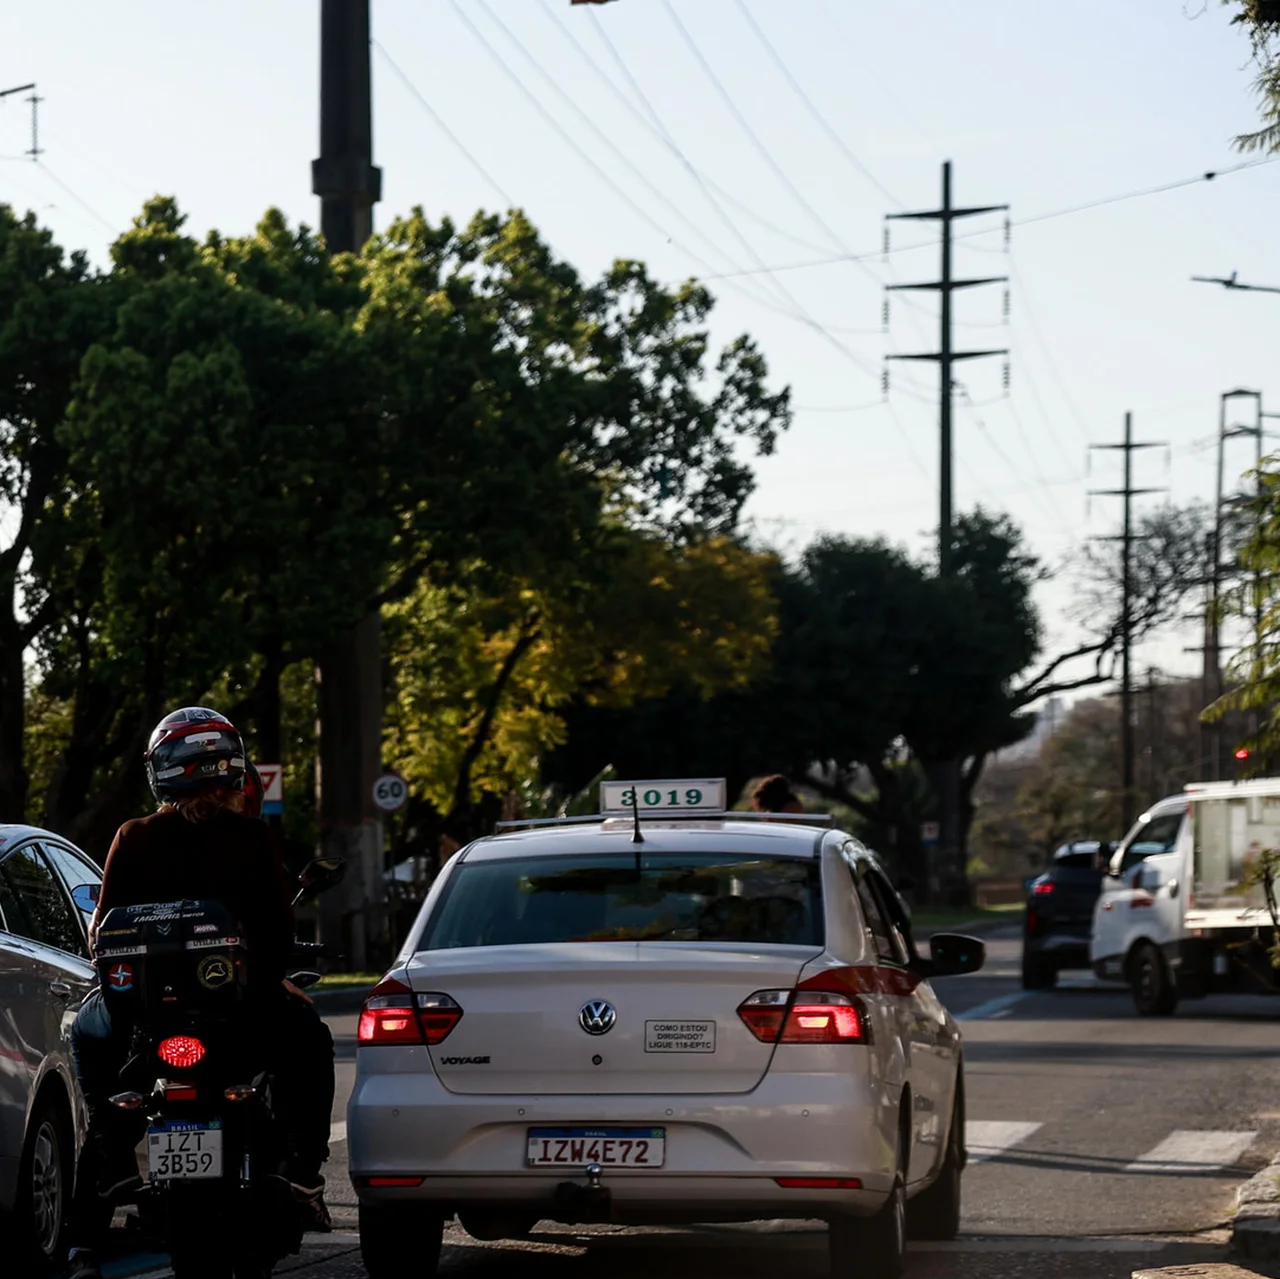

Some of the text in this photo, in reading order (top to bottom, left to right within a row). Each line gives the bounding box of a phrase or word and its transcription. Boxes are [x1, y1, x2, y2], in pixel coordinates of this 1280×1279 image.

[377, 781, 403, 799] 60
[621, 789, 703, 806] 3019
[440, 1056, 491, 1065] VOYAGE
[171, 1124, 200, 1132] BRASIL
[164, 1131, 206, 1153] IZT
[538, 1140, 650, 1163] IZW4E72
[157, 1153, 213, 1175] 3B59
